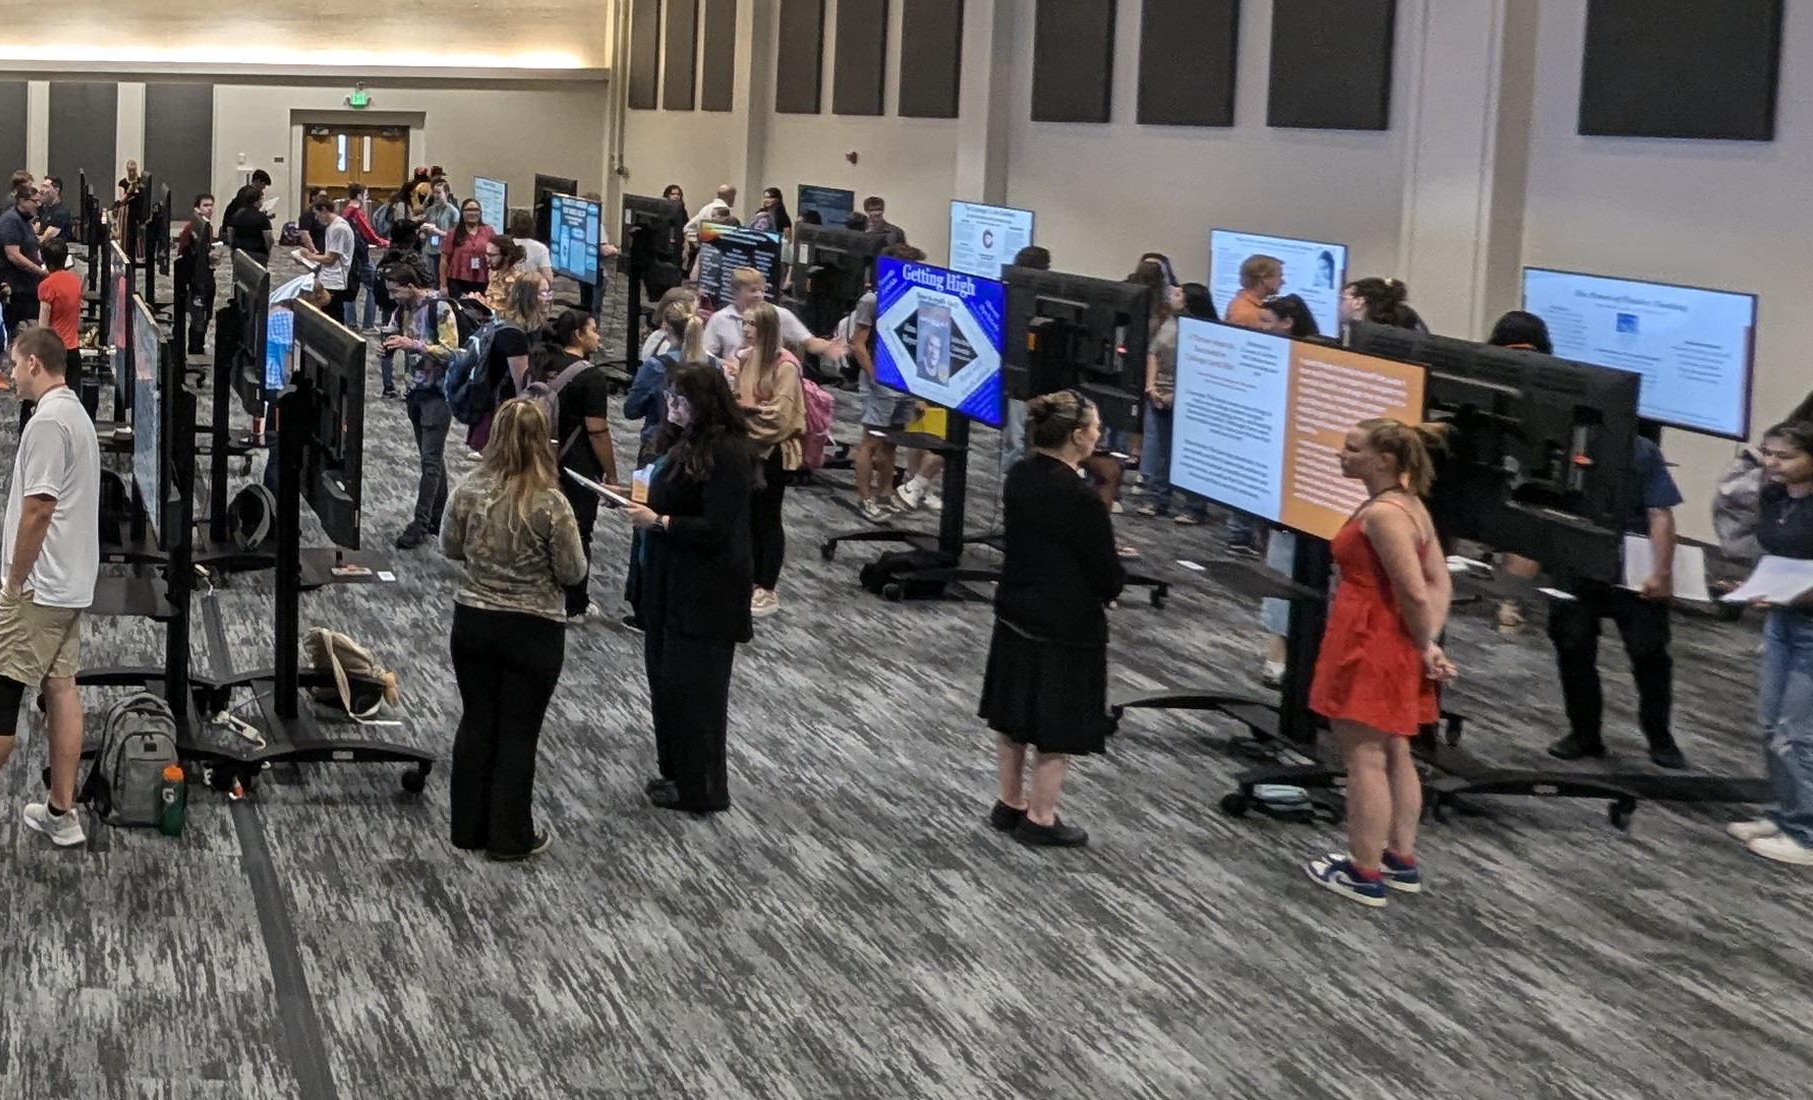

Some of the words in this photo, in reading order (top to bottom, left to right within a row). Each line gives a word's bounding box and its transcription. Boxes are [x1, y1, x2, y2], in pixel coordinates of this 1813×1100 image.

[902, 263, 945, 293] Getting
[946, 273, 976, 299] High
[162, 787, 176, 803] G
